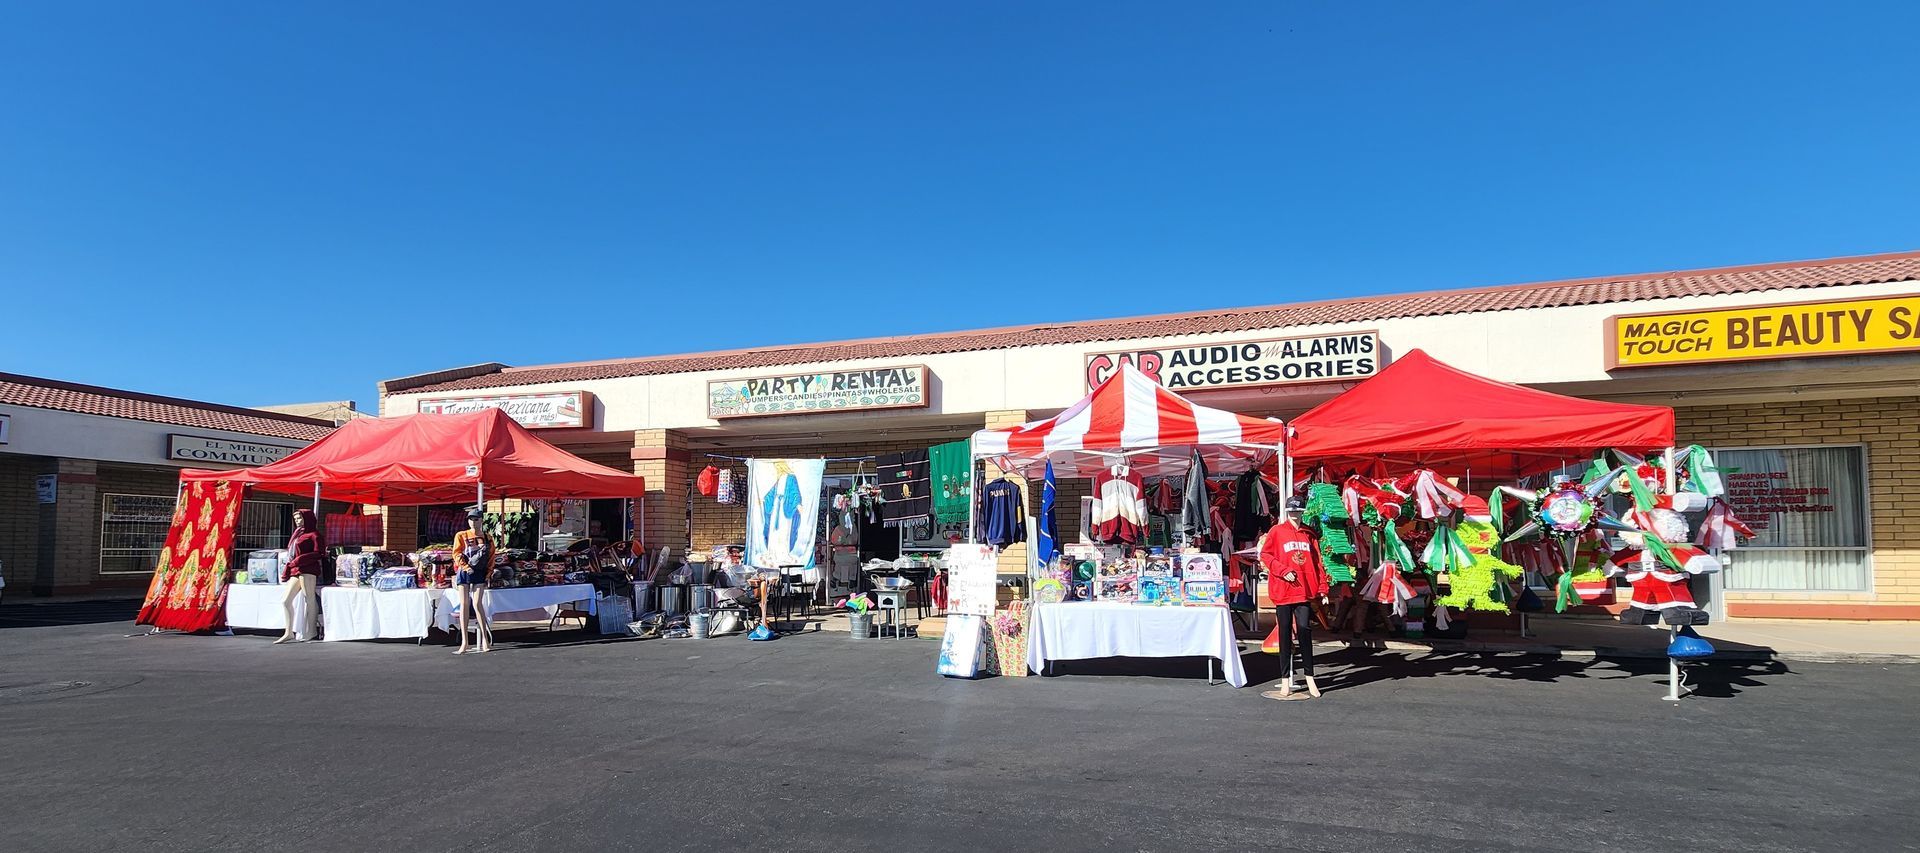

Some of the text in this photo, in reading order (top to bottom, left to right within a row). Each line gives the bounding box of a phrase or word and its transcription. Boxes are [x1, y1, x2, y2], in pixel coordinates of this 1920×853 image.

[1624, 318, 1709, 338] MAGIC
[1727, 308, 1873, 350] BEAUTY
[1169, 334, 1374, 368] AUDIO ALARMS
[1624, 336, 1712, 356] TOUCH
[747, 367, 917, 397] PARTY RENTAL
[1167, 357, 1375, 388] ACCESSORIES
[787, 392, 824, 401] CANDIES
[866, 385, 921, 396] WHOLESALE
[205, 441, 223, 449] EL
[229, 443, 282, 454] MIRAGE
[1728, 480, 1769, 488] HAIRCUTS
